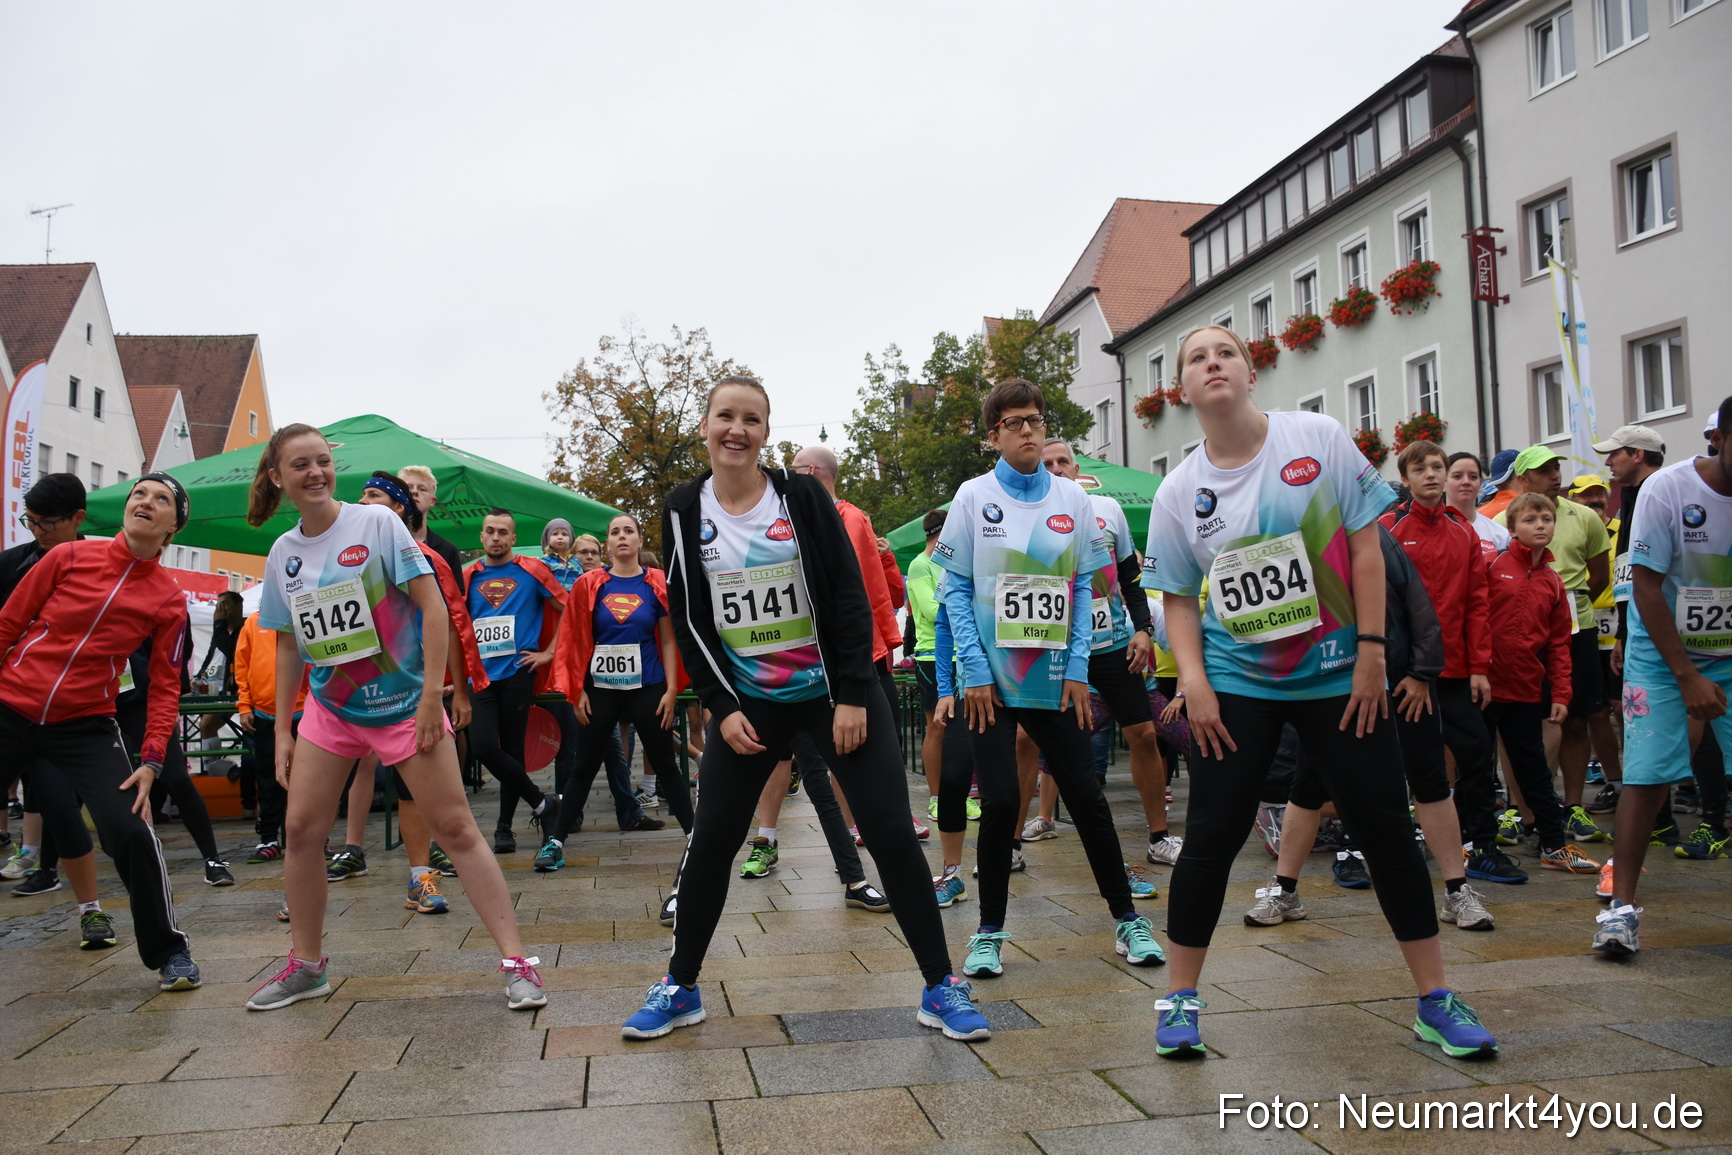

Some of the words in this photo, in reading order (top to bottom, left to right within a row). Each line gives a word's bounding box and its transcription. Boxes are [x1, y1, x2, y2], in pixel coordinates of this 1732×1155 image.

[1477, 244, 1491, 296] Achatz
[1285, 463, 1316, 480] Hervis
[983, 526, 1006, 534] PARTL
[1051, 519, 1072, 529] Hervis
[1197, 517, 1225, 533] PARTL
[341, 549, 367, 562] Hervis
[700, 547, 720, 556] ARTL
[1244, 538, 1296, 562] BOCK
[750, 564, 797, 581] BOCK
[1614, 565, 1632, 586] 342
[286, 579, 304, 589] PARTL
[317, 583, 356, 600] BOCK
[1219, 558, 1308, 612] 5034
[721, 583, 799, 625] 5141
[1004, 592, 1065, 620] 5139
[299, 600, 365, 640] 5142
[1232, 605, 1312, 634] Anna-Carina
[475, 626, 510, 644] 2088
[750, 629, 781, 643] Anna
[1023, 627, 1049, 638] Klara
[324, 642, 348, 655] Lena
[1319, 640, 1344, 658] 17.
[1686, 637, 1732, 647] Moham
[596, 655, 635, 673] 2061
[1050, 650, 1063, 663] 17.
[605, 677, 629, 685] Antonia
[362, 683, 384, 697] 17.
[364, 691, 409, 706] Neumarkter
[367, 701, 403, 713] Stadtlauf
